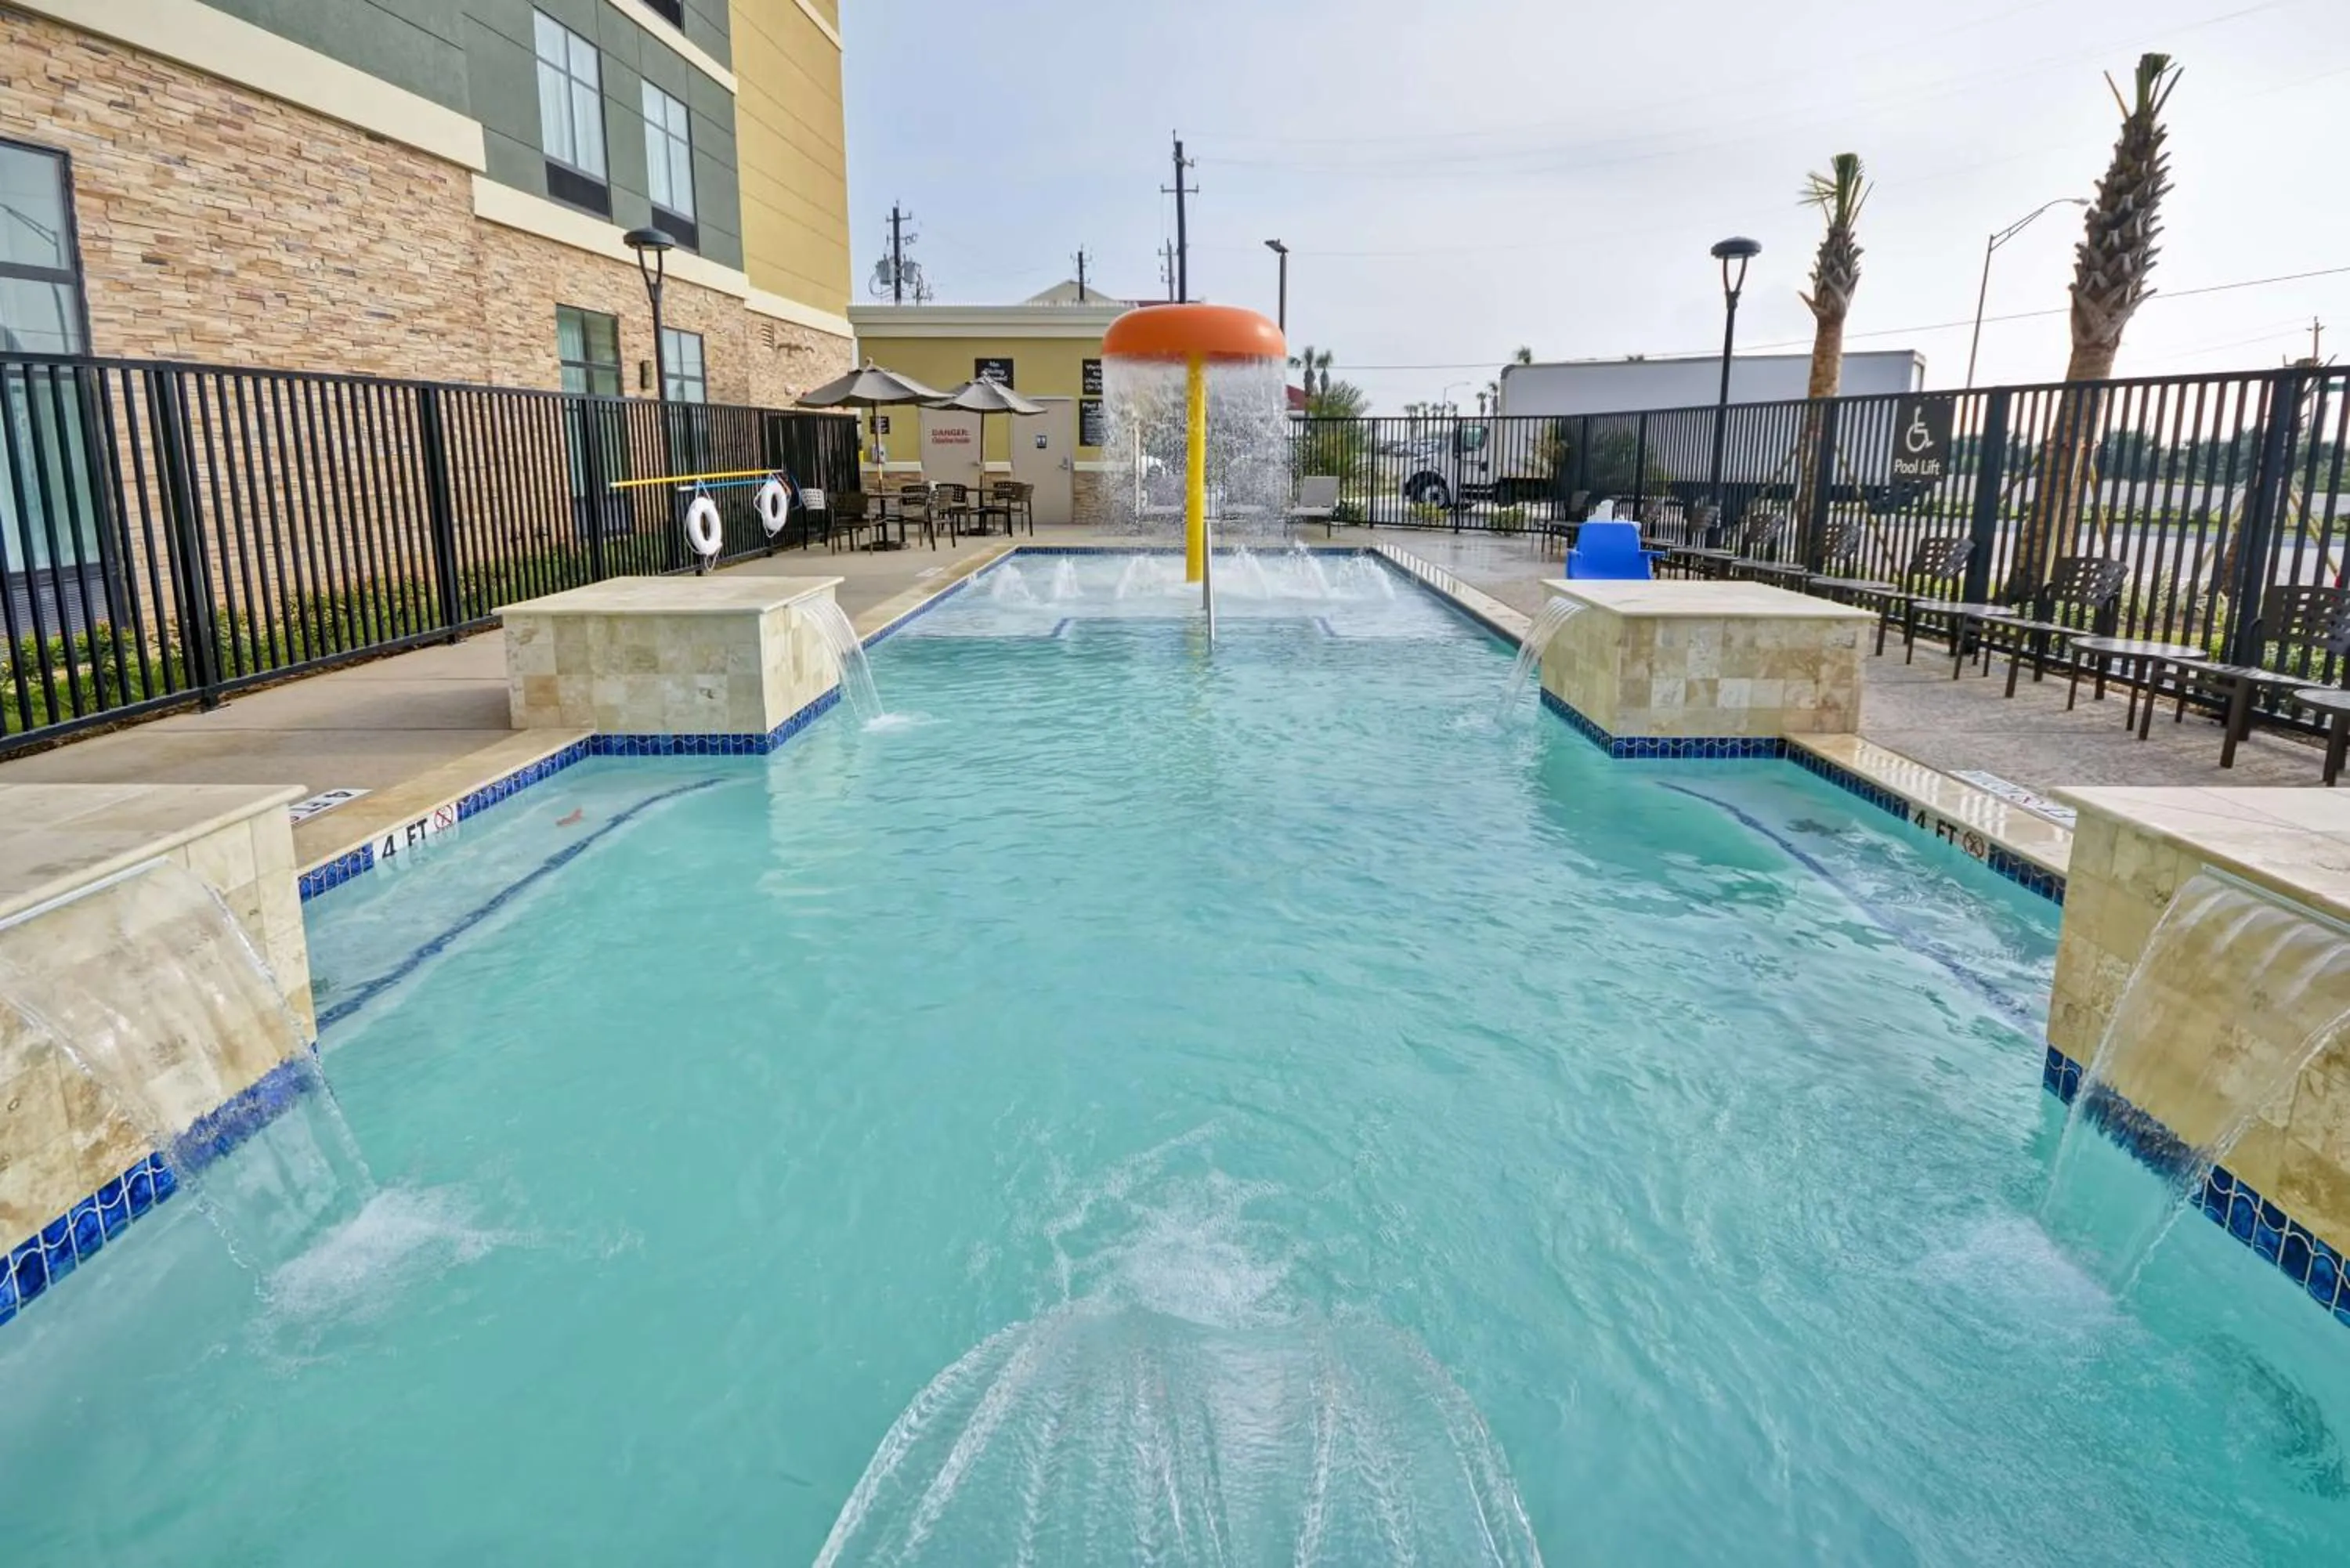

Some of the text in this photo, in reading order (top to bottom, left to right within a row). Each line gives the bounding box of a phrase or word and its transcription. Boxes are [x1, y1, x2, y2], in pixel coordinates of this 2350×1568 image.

[1894, 457, 1941, 476] Pool Lift
[381, 817, 428, 859] 4 FT
[1914, 810, 1958, 846] 4 FT
